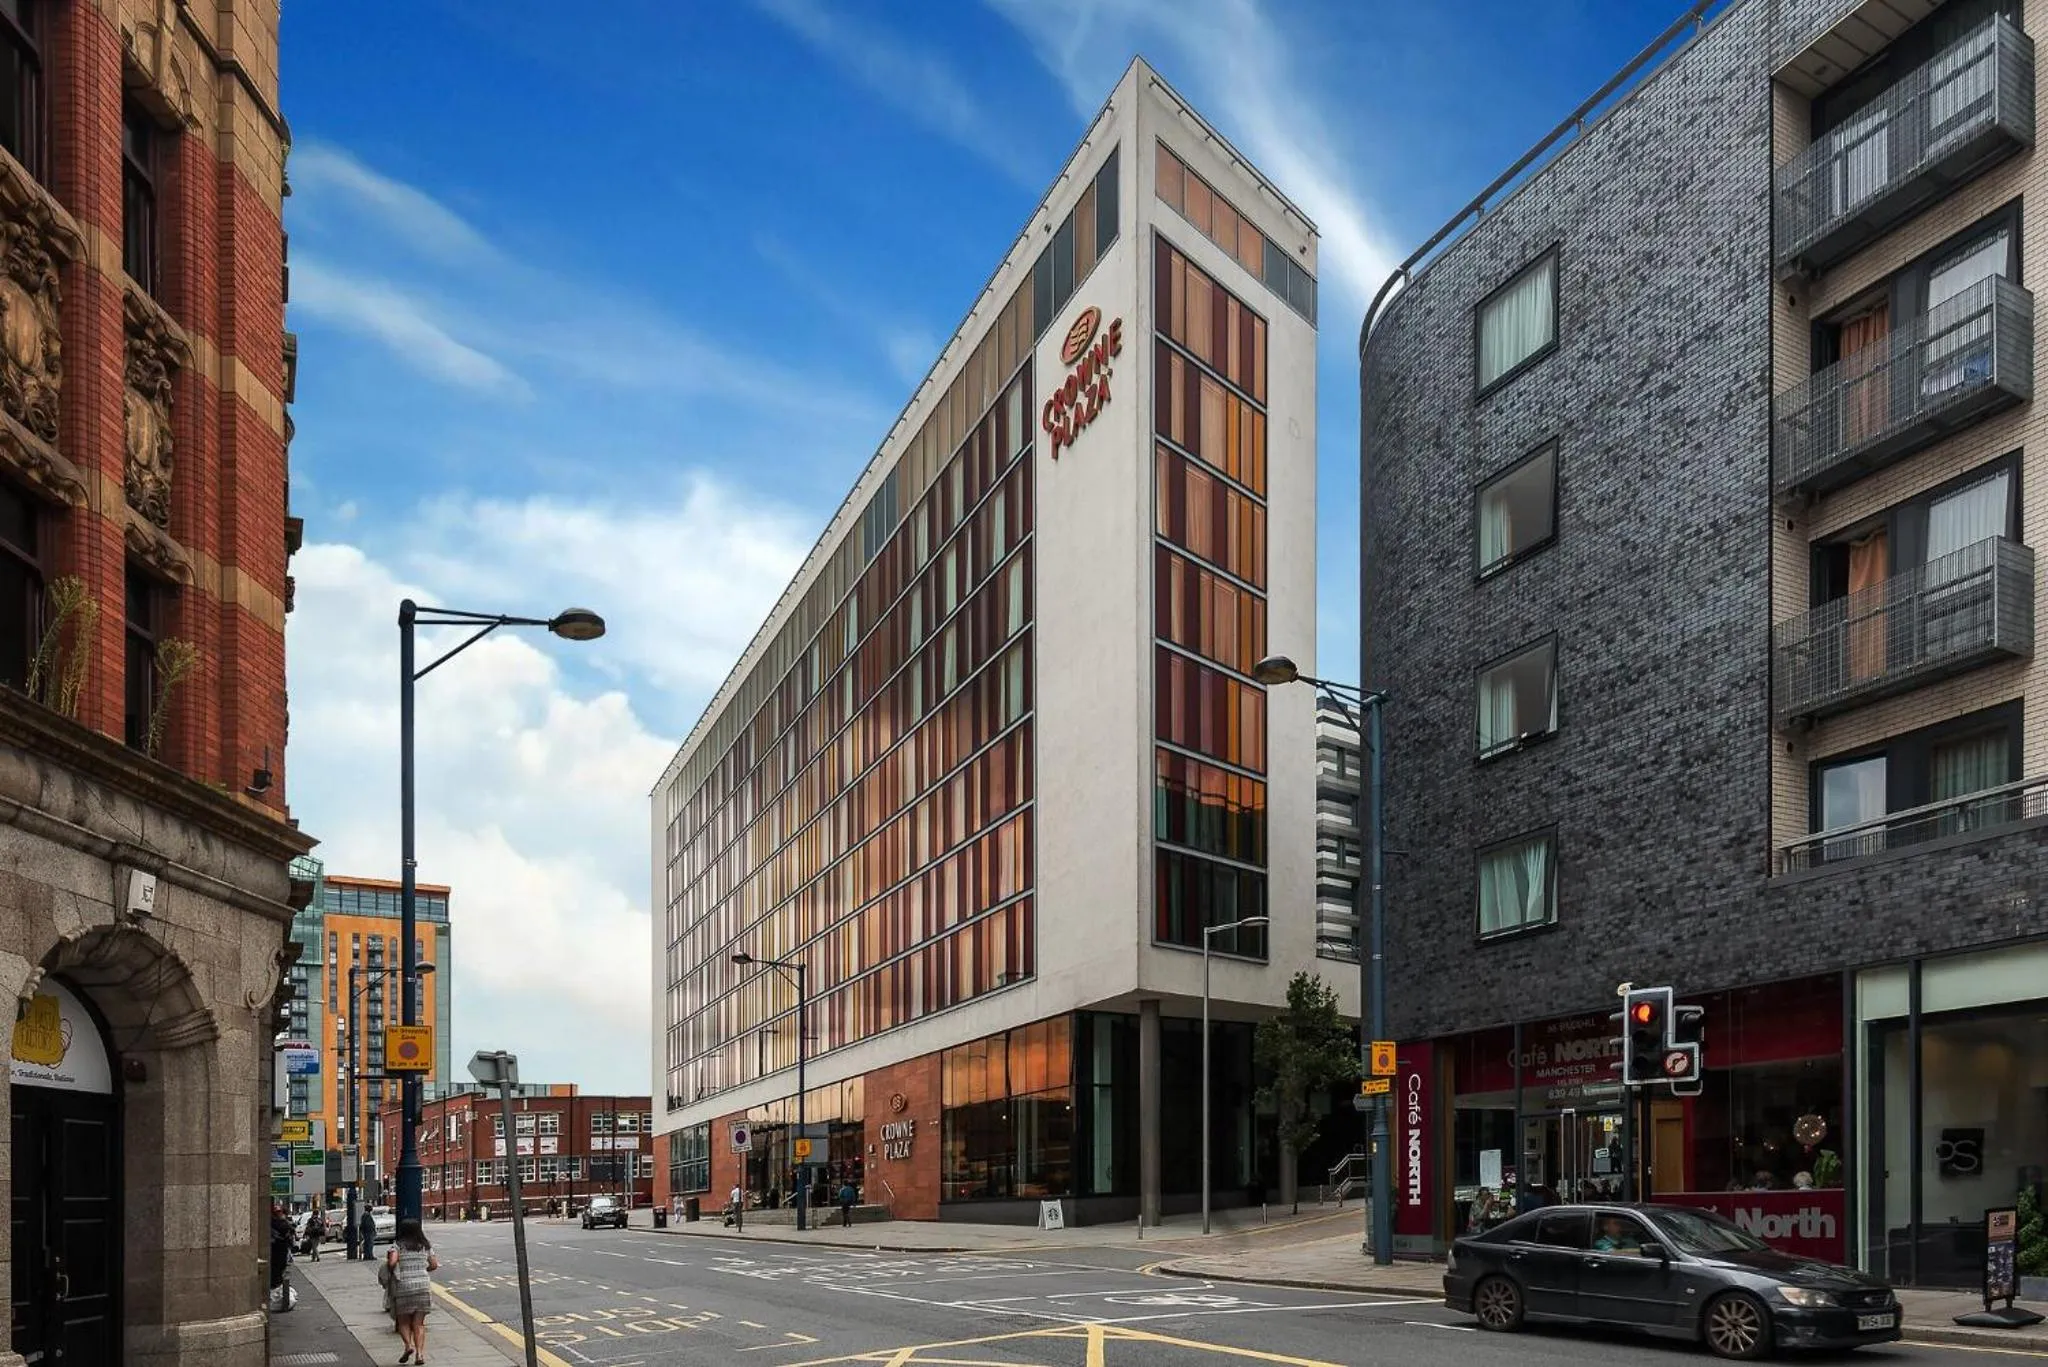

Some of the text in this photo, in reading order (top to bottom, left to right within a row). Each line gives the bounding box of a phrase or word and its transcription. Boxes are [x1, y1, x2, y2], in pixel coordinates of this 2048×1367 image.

[1042, 317, 1122, 433] CROWNE
[1051, 372, 1112, 462] PLAZA
[1507, 1043, 1548, 1068] Café
[1536, 1064, 1597, 1078] MANCHESTER
[880, 1119, 913, 1141] CROWNE
[1408, 1073, 1422, 1206] Café NORTH
[884, 1140, 910, 1161] PLAZA
[1735, 1207, 1836, 1238] North
[533, 1306, 657, 1327] BUS
